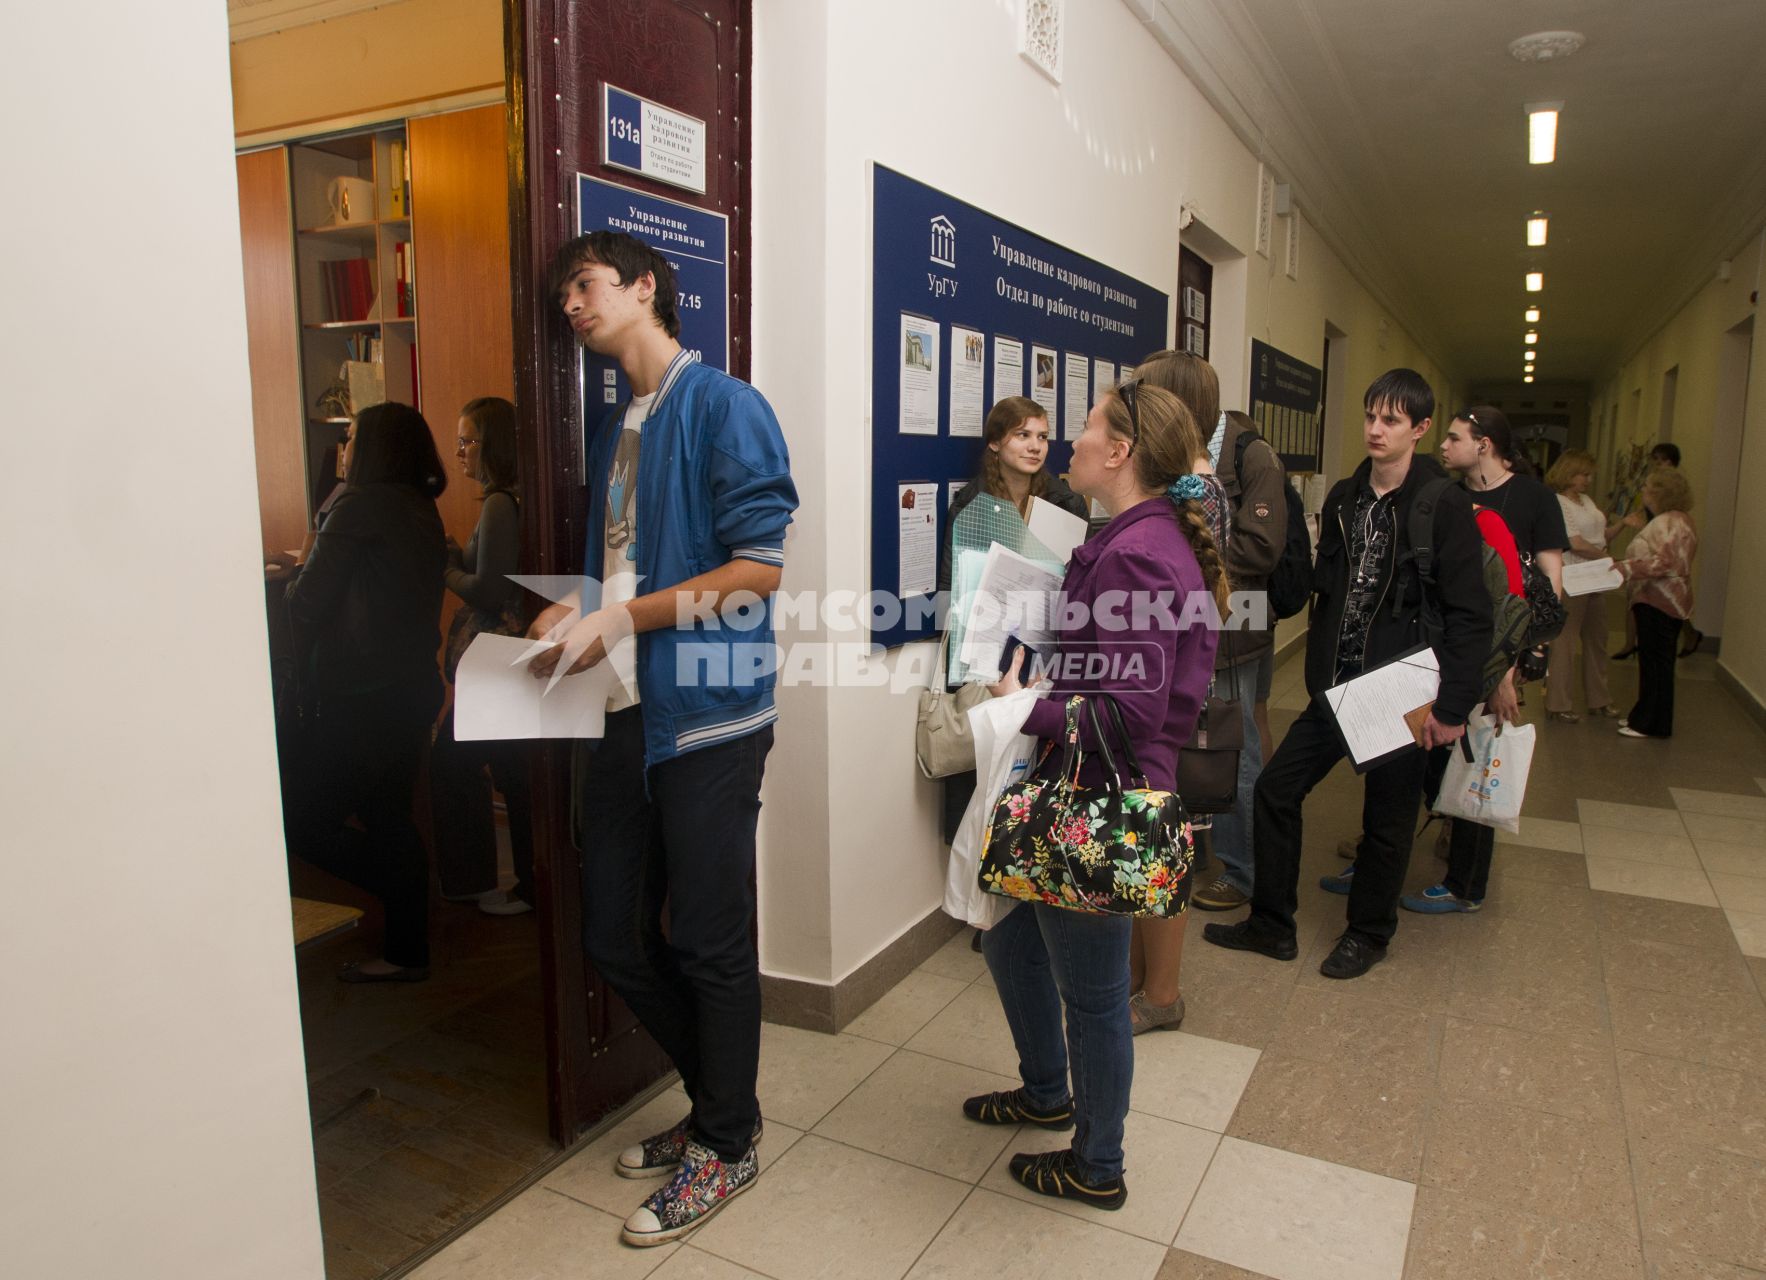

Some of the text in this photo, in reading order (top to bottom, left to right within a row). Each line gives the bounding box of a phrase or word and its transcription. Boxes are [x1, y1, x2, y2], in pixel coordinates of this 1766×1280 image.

[647, 110, 696, 136] Управление
[651, 124, 693, 144] кадрового
[652, 135, 691, 153] развития
[629, 206, 688, 231] Управление
[608, 217, 705, 248] кадрового развития
[928, 272, 959, 298] УрГУ
[991, 235, 1138, 310] Управление кадрового развития
[676, 292, 702, 310] 7.15
[996, 277, 1135, 337] Отдел по работе со студентами
